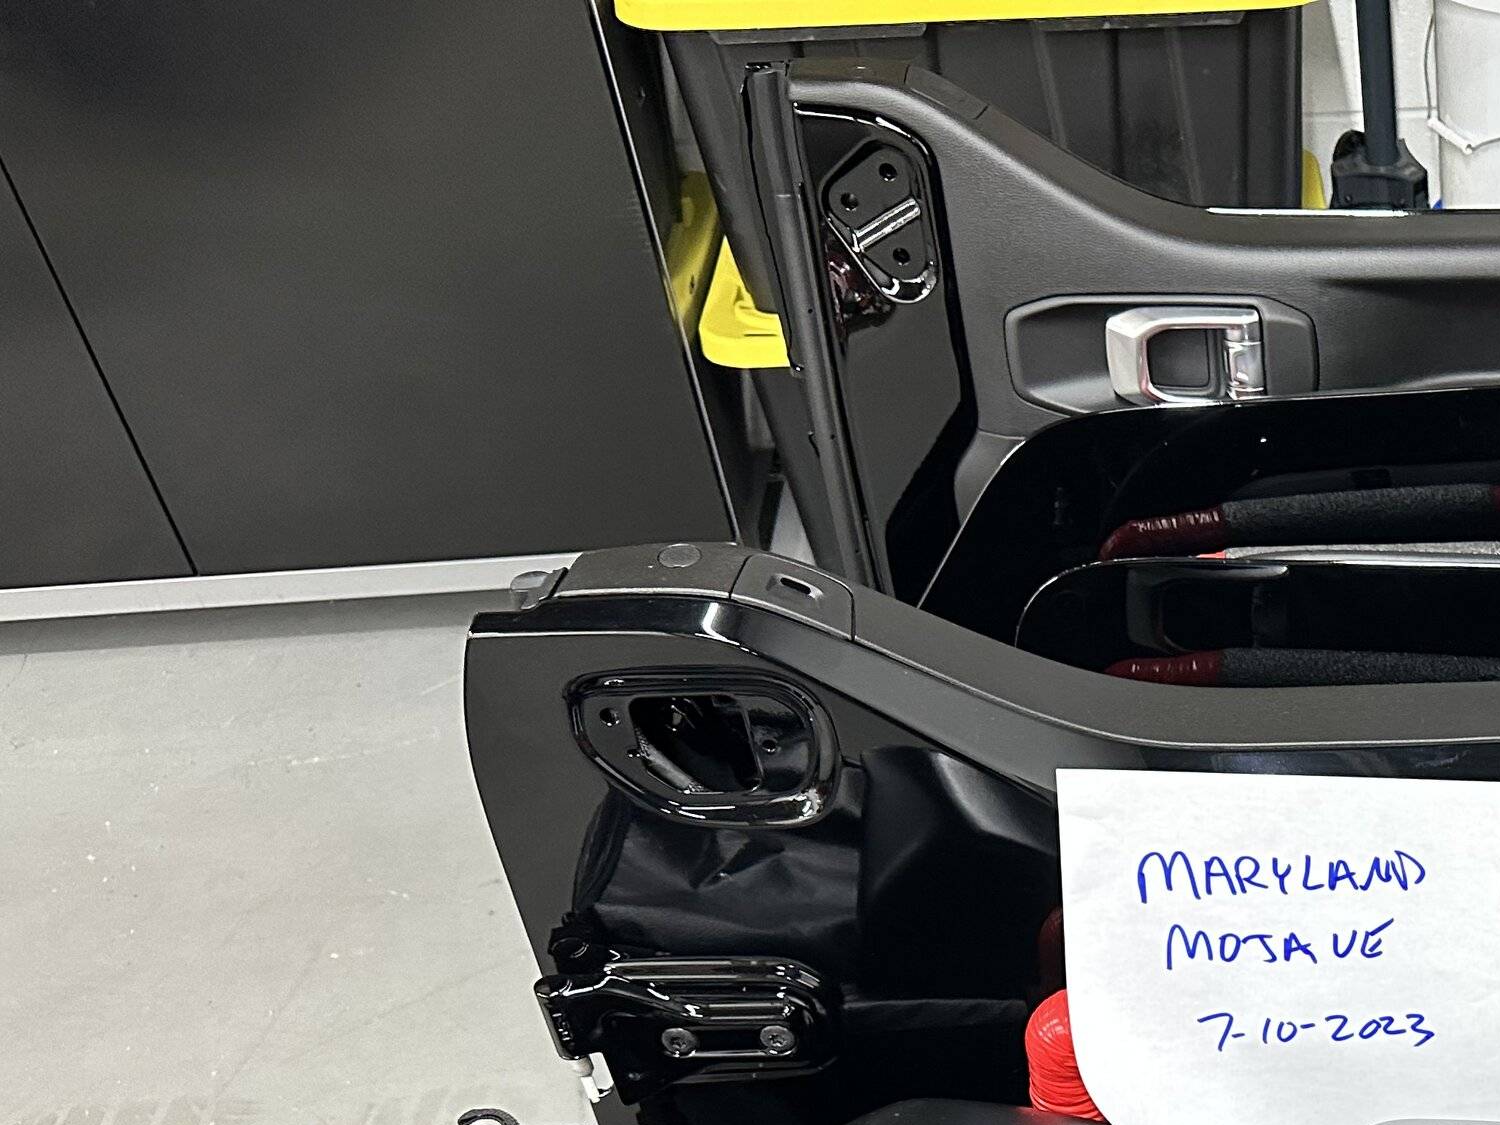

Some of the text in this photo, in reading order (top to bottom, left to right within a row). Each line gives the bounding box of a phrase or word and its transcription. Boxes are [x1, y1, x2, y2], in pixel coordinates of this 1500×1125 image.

[1136, 849, 1426, 903] MARYLAND
[1166, 918, 1393, 970] MOJAVE
[1197, 1012, 1436, 1051] 7-10-2023
